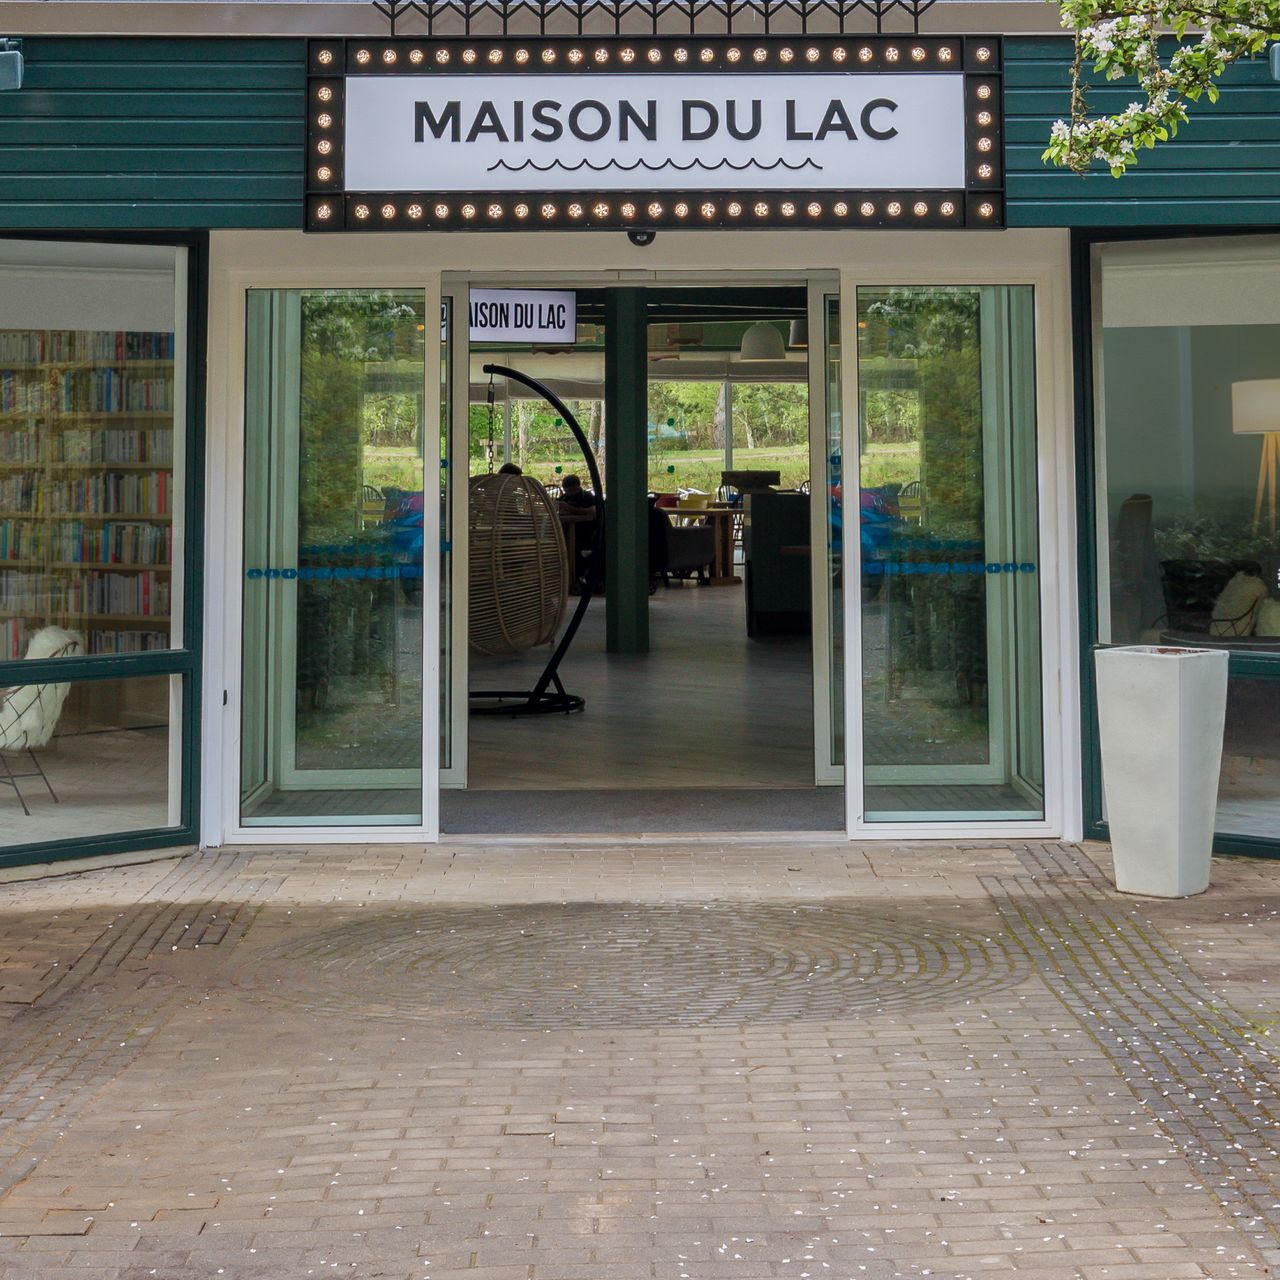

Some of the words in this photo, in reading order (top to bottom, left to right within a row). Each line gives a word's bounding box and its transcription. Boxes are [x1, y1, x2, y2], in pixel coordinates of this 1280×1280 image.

[414, 99, 657, 143] MAISON
[681, 99, 762, 142] DU
[785, 98, 899, 141] LAC
[513, 302, 534, 329] DU
[538, 303, 566, 330] LAC
